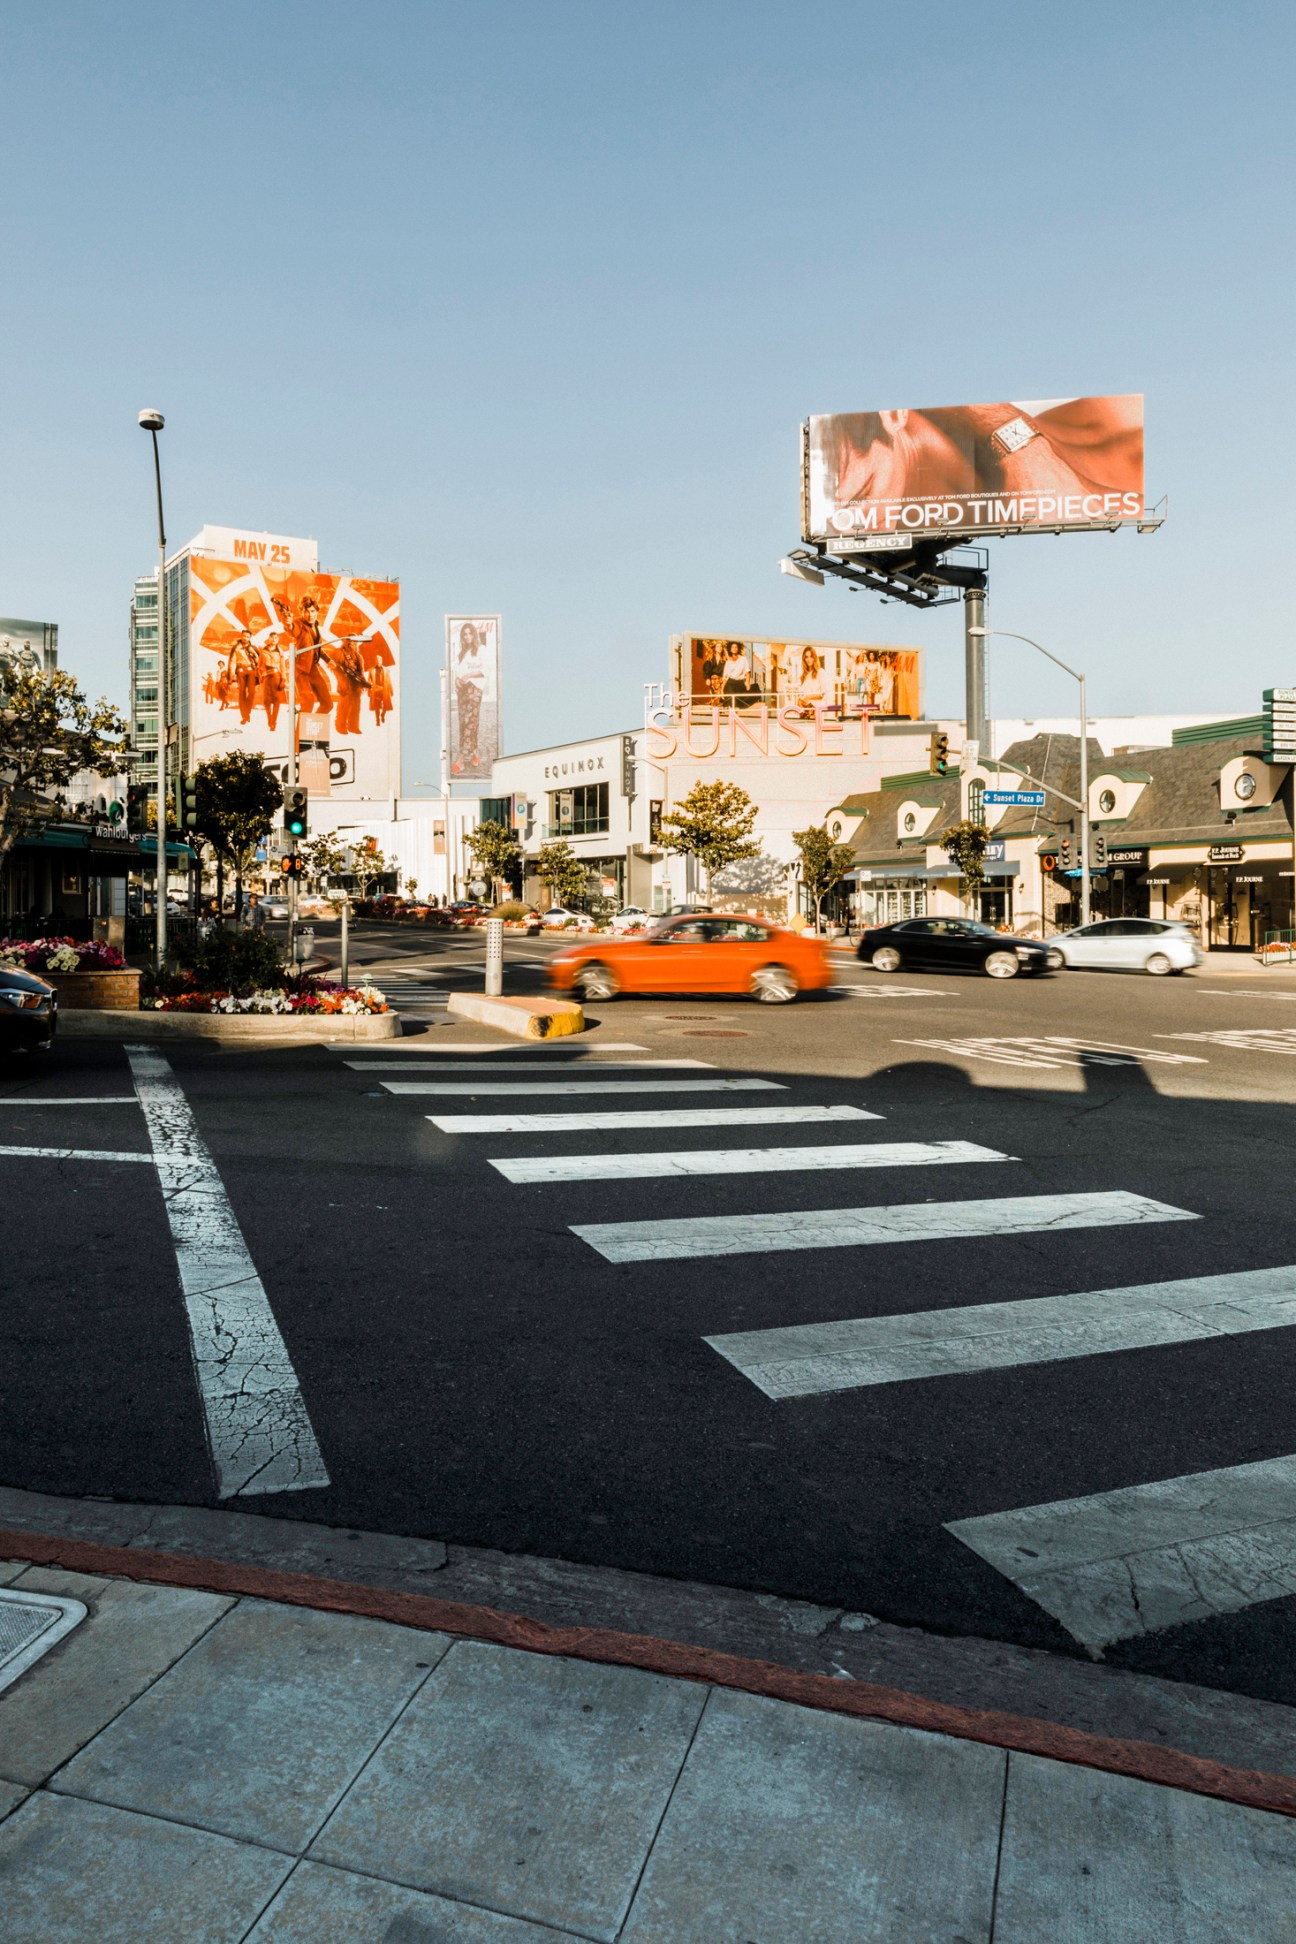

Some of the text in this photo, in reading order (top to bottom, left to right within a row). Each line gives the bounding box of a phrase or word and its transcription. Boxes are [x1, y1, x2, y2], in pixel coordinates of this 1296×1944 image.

[885, 502, 964, 528] FORD
[967, 492, 1140, 524] TIMEPIECES
[234, 538, 291, 564] MAY 25
[833, 537, 907, 550] REGENCY
[644, 682, 691, 708] The
[647, 703, 880, 759] SUNSET
[544, 757, 605, 779] EQUINOX
[624, 738, 632, 793] EQINOX
[993, 793, 1044, 803] Sunset Plaza Dr
[1113, 852, 1142, 861] GROUP
